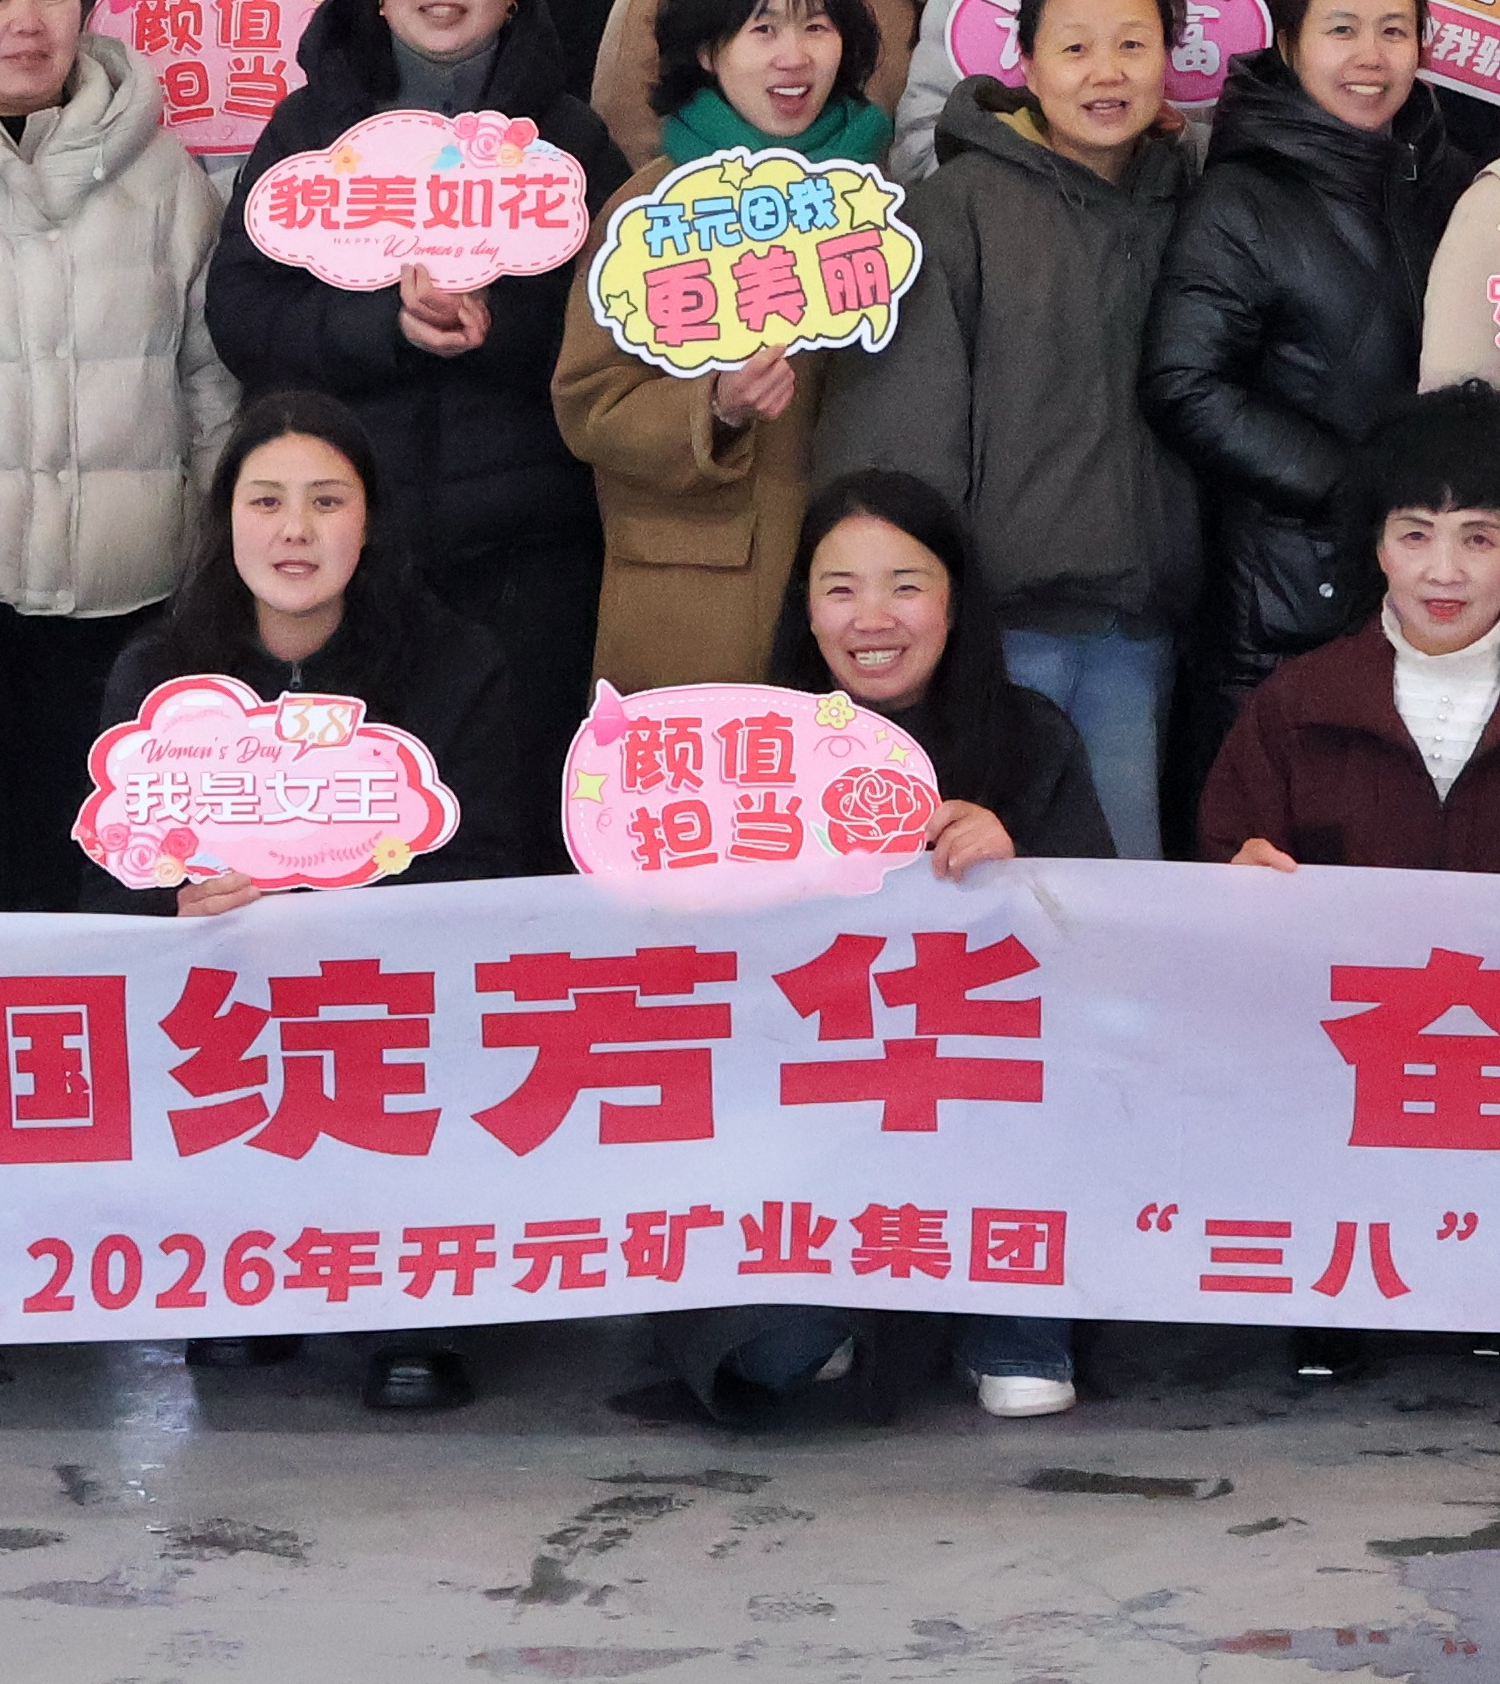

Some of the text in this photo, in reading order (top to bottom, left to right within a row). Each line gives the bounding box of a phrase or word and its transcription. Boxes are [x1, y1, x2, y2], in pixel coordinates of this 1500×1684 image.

[268, 173, 571, 230] 貌美如花
[643, 177, 840, 258] 开元因我
[643, 228, 891, 348] 更美丽
[141, 736, 285, 764] Women's Day
[620, 711, 798, 795] 颜值
[124, 770, 401, 826] 我是女王
[628, 791, 805, 872] 担当
